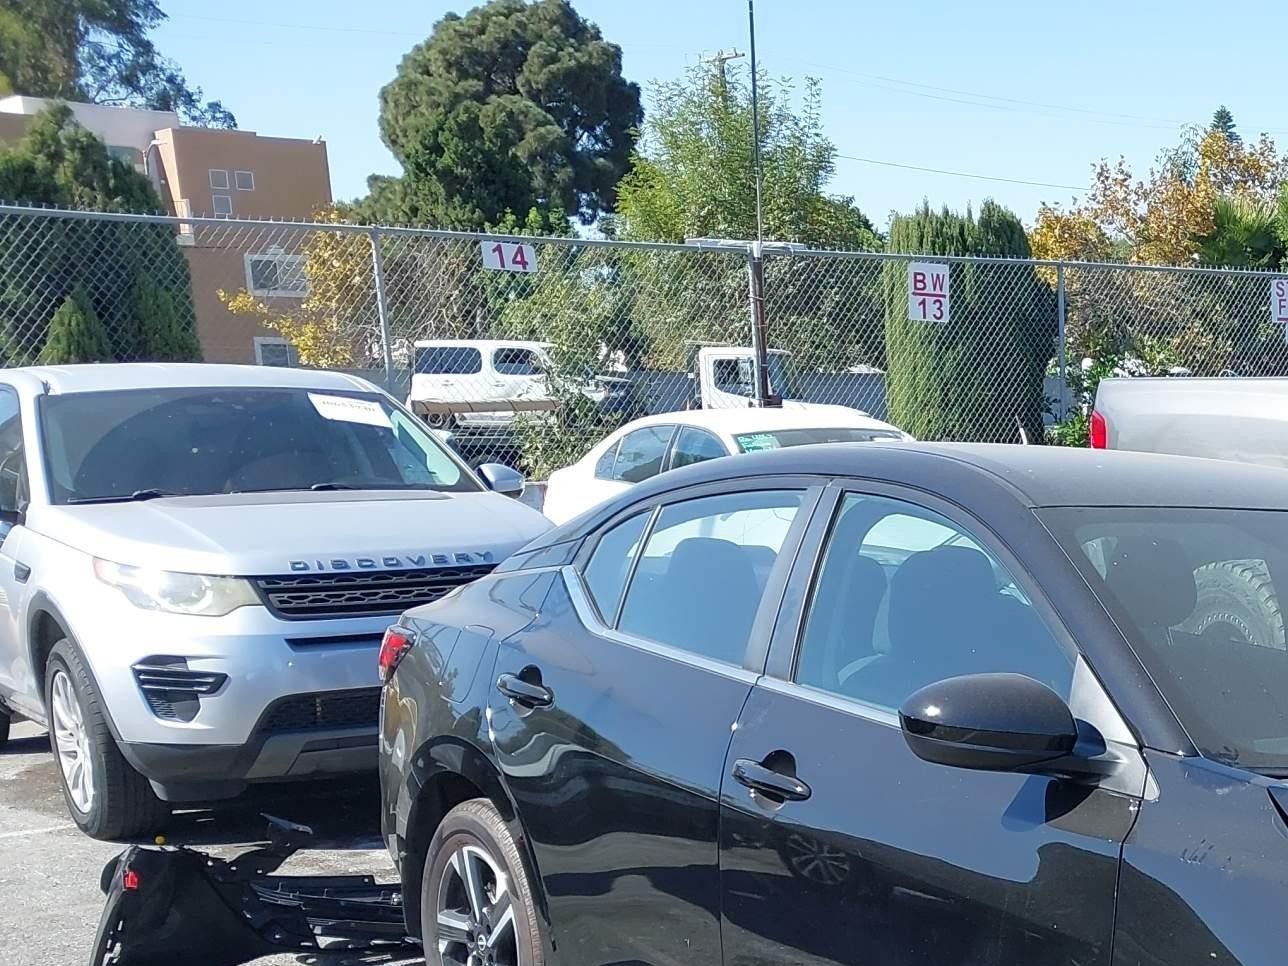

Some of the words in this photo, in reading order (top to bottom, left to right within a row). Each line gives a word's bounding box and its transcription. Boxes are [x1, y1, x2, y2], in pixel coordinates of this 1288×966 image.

[491, 243, 529, 270] 14
[913, 271, 945, 292] BW
[917, 297, 944, 321] 13
[288, 550, 495, 572] DISCOVERY
